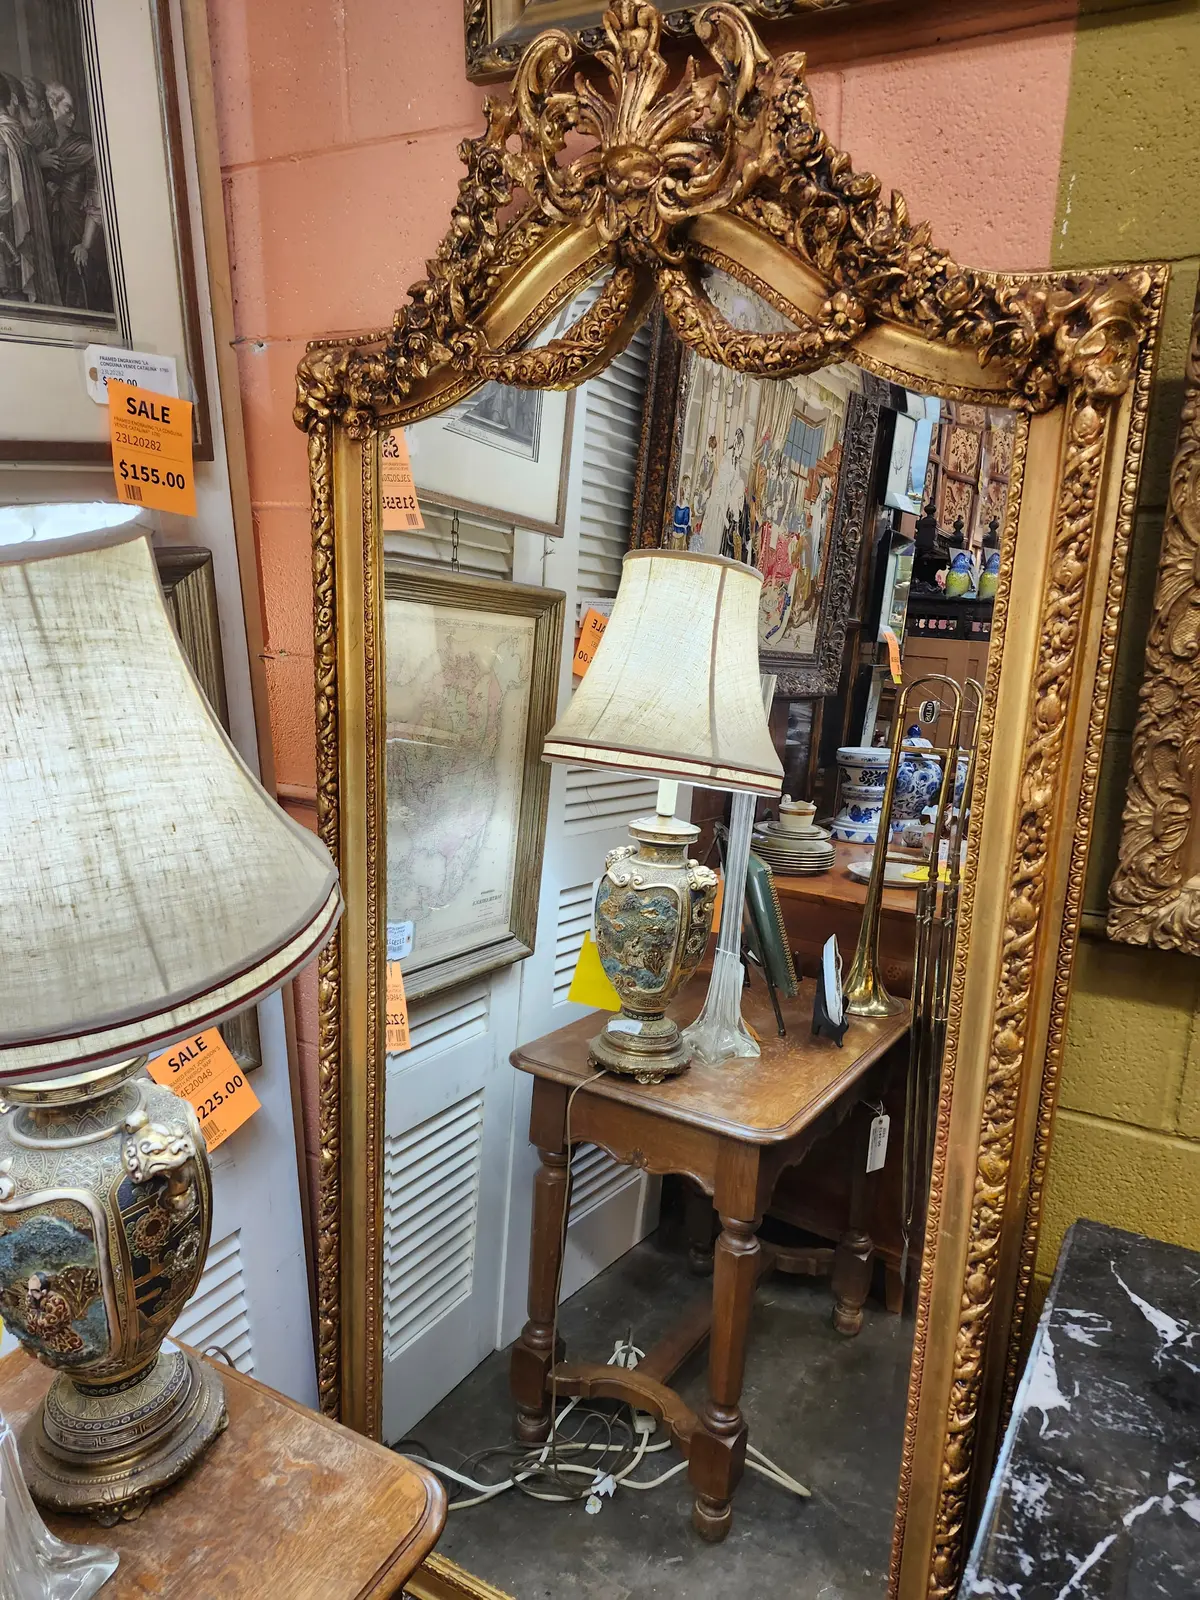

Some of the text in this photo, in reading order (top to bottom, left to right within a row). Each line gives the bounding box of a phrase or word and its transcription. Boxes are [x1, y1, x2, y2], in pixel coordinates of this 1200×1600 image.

[117, 357, 142, 365] ENGRAVING
[126, 397, 171, 425] SALE
[115, 431, 162, 452] 23L20282
[119, 459, 186, 490] $155.00
[168, 1036, 208, 1073] SALE
[197, 1045, 221, 1067] JOHNSON'S
[176, 1068, 213, 1098] 4E20048
[185, 1066, 203, 1082] AMERICA
[202, 1059, 212, 1069] MAP
[197, 1075, 243, 1122] 225.00
